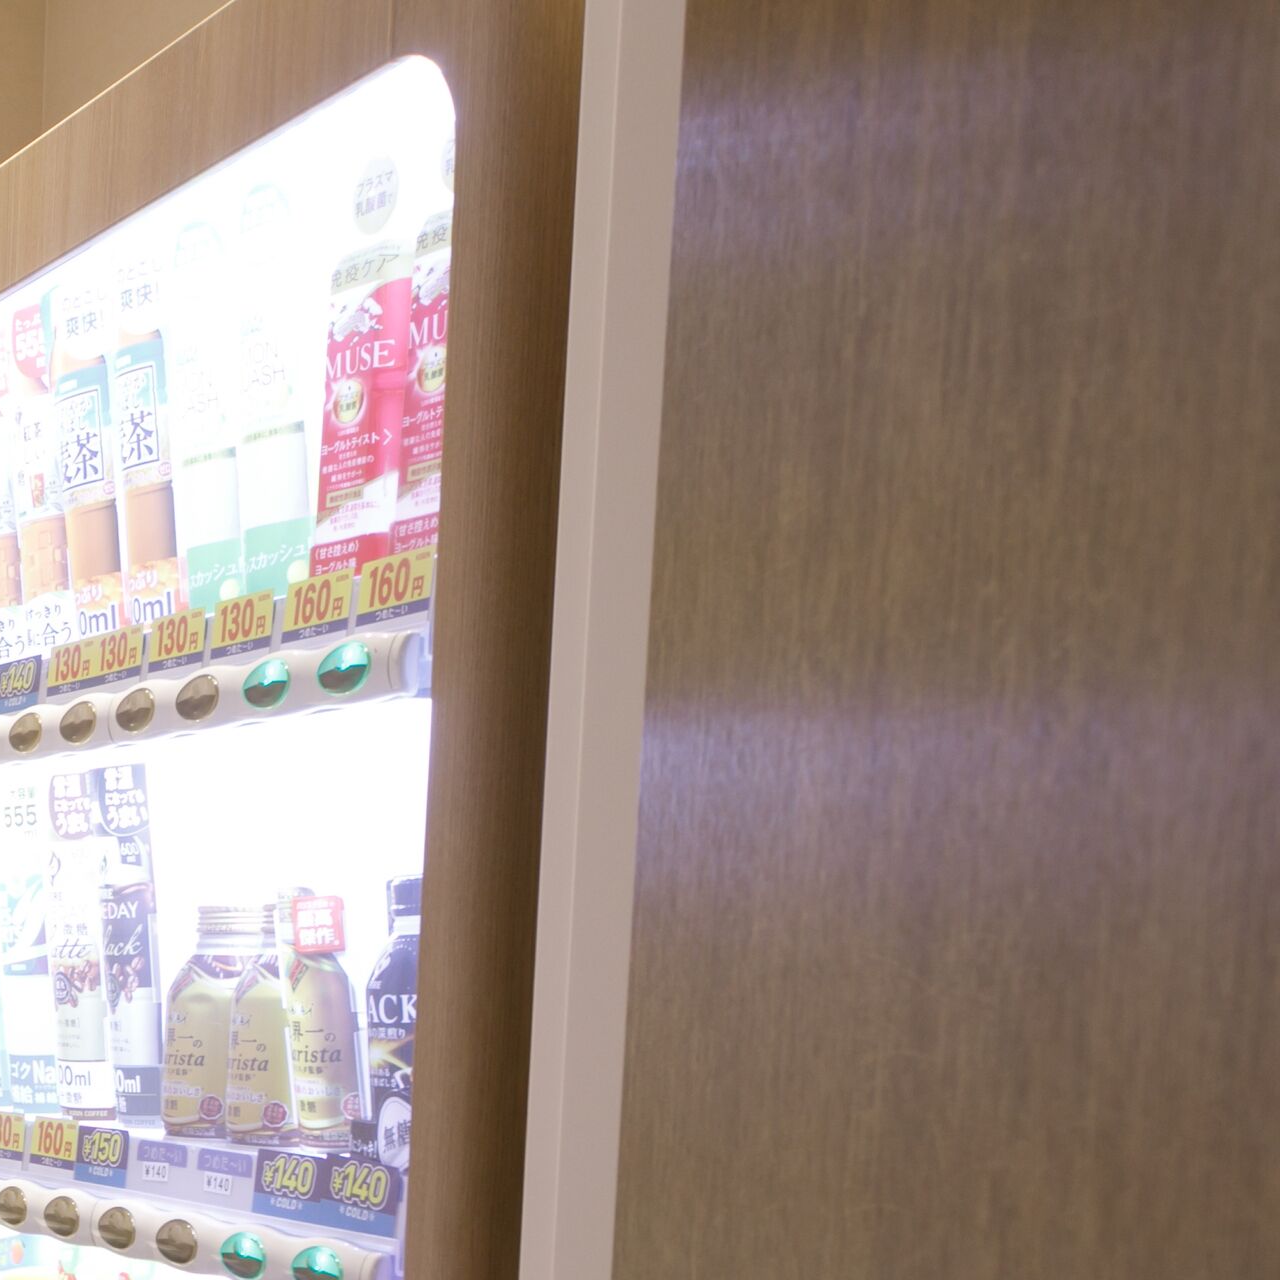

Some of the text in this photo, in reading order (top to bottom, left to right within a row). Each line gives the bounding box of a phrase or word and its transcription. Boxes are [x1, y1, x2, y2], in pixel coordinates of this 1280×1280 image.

[369, 557, 425, 608] 160円
[221, 598, 266, 643] 130円
[294, 579, 344, 626] 160円
[100, 632, 137, 672] 130円
[157, 615, 199, 657] 130円
[55, 644, 90, 681] 130円
[3, 804, 37, 828] 555
[38, 1121, 72, 1158] 160円
[83, 1131, 122, 1164] ¥150
[144, 1164, 167, 1179] ¥140
[206, 1177, 230, 1193] ¥140
[263, 1156, 315, 1195] ¥140
[332, 1164, 386, 1206] ¥140
